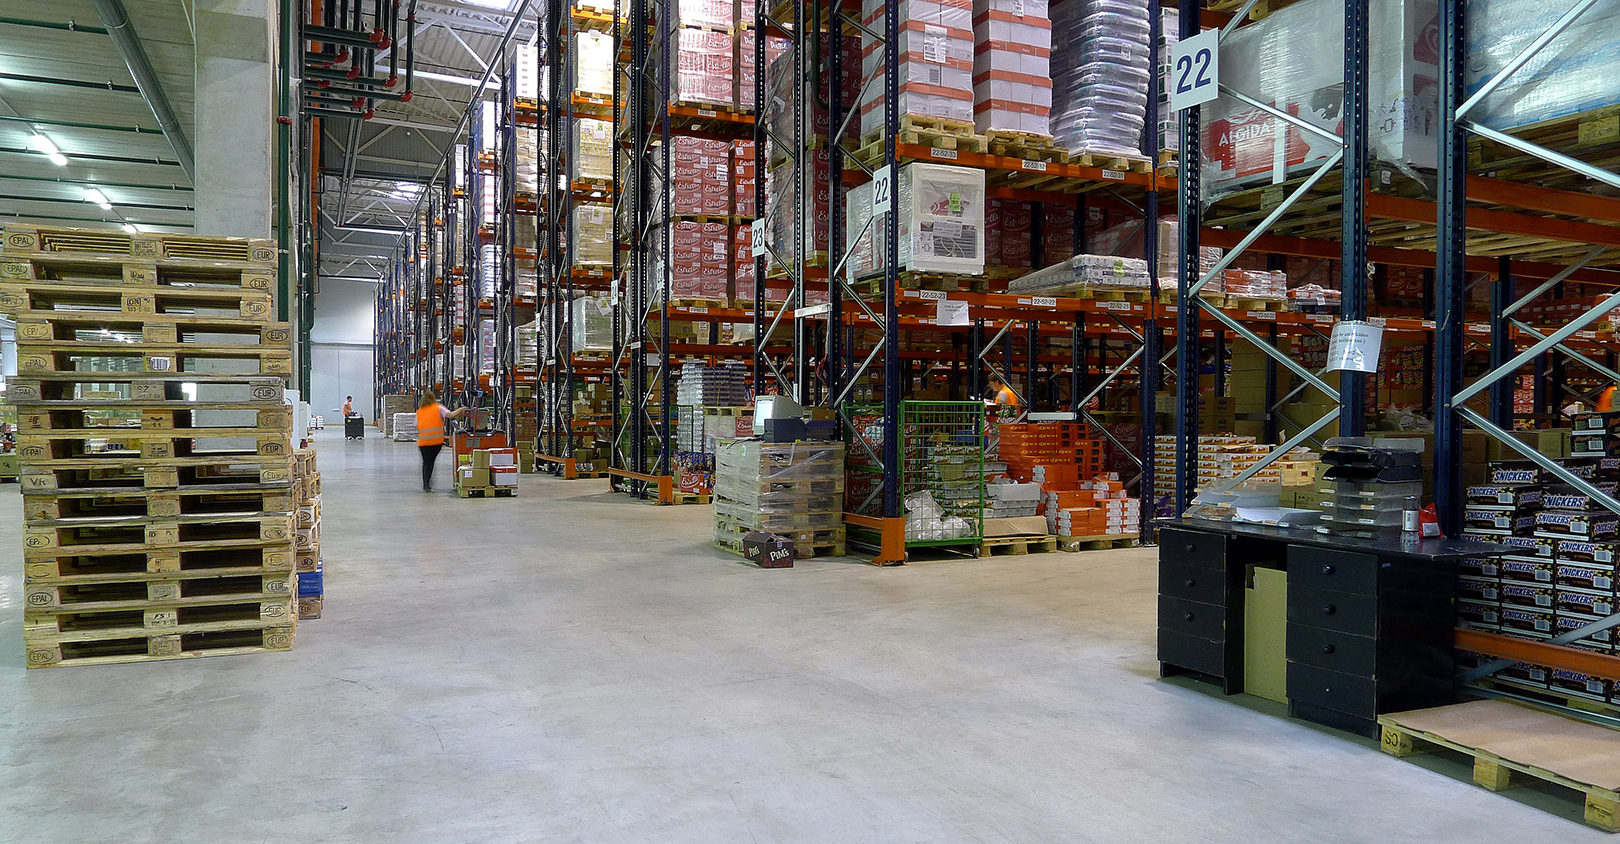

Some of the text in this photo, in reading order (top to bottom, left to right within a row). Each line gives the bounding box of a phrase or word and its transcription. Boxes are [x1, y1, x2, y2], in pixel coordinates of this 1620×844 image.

[1177, 48, 1211, 94] 22
[1219, 121, 1270, 146] ALGIDA
[932, 149, 956, 158] 22-52-33
[875, 178, 888, 204] 22
[1004, 213, 1029, 225] Estrella
[13, 236, 30, 244] EPAL
[754, 227, 763, 248] 23
[257, 250, 270, 259] EUR
[7, 264, 23, 272] EPAL
[254, 280, 267, 288] EUR
[921, 291, 946, 299] 22-52-23
[248, 304, 262, 312] EUR
[270, 332, 284, 340] EUR
[258, 389, 272, 397] EUR
[265, 445, 279, 453] EUR
[1494, 471, 1534, 481] SNICKERS
[1469, 488, 1498, 496] SNICKERS
[1542, 496, 1585, 507] SNICKERS
[1466, 512, 1495, 520] SNICKERS
[1538, 514, 1571, 524] SNICKERS
[1505, 537, 1534, 546] SNICKERS
[1560, 541, 1594, 552] SNICKERS
[1504, 562, 1534, 571] SNICKERS
[1560, 567, 1593, 578] SNICKERS
[271, 583, 284, 591] EUR
[1505, 586, 1535, 596] SNICKERS
[1560, 593, 1593, 604] SNICKERS
[1504, 610, 1534, 620] SNICKERS
[1554, 669, 1588, 681] SNICKERS
